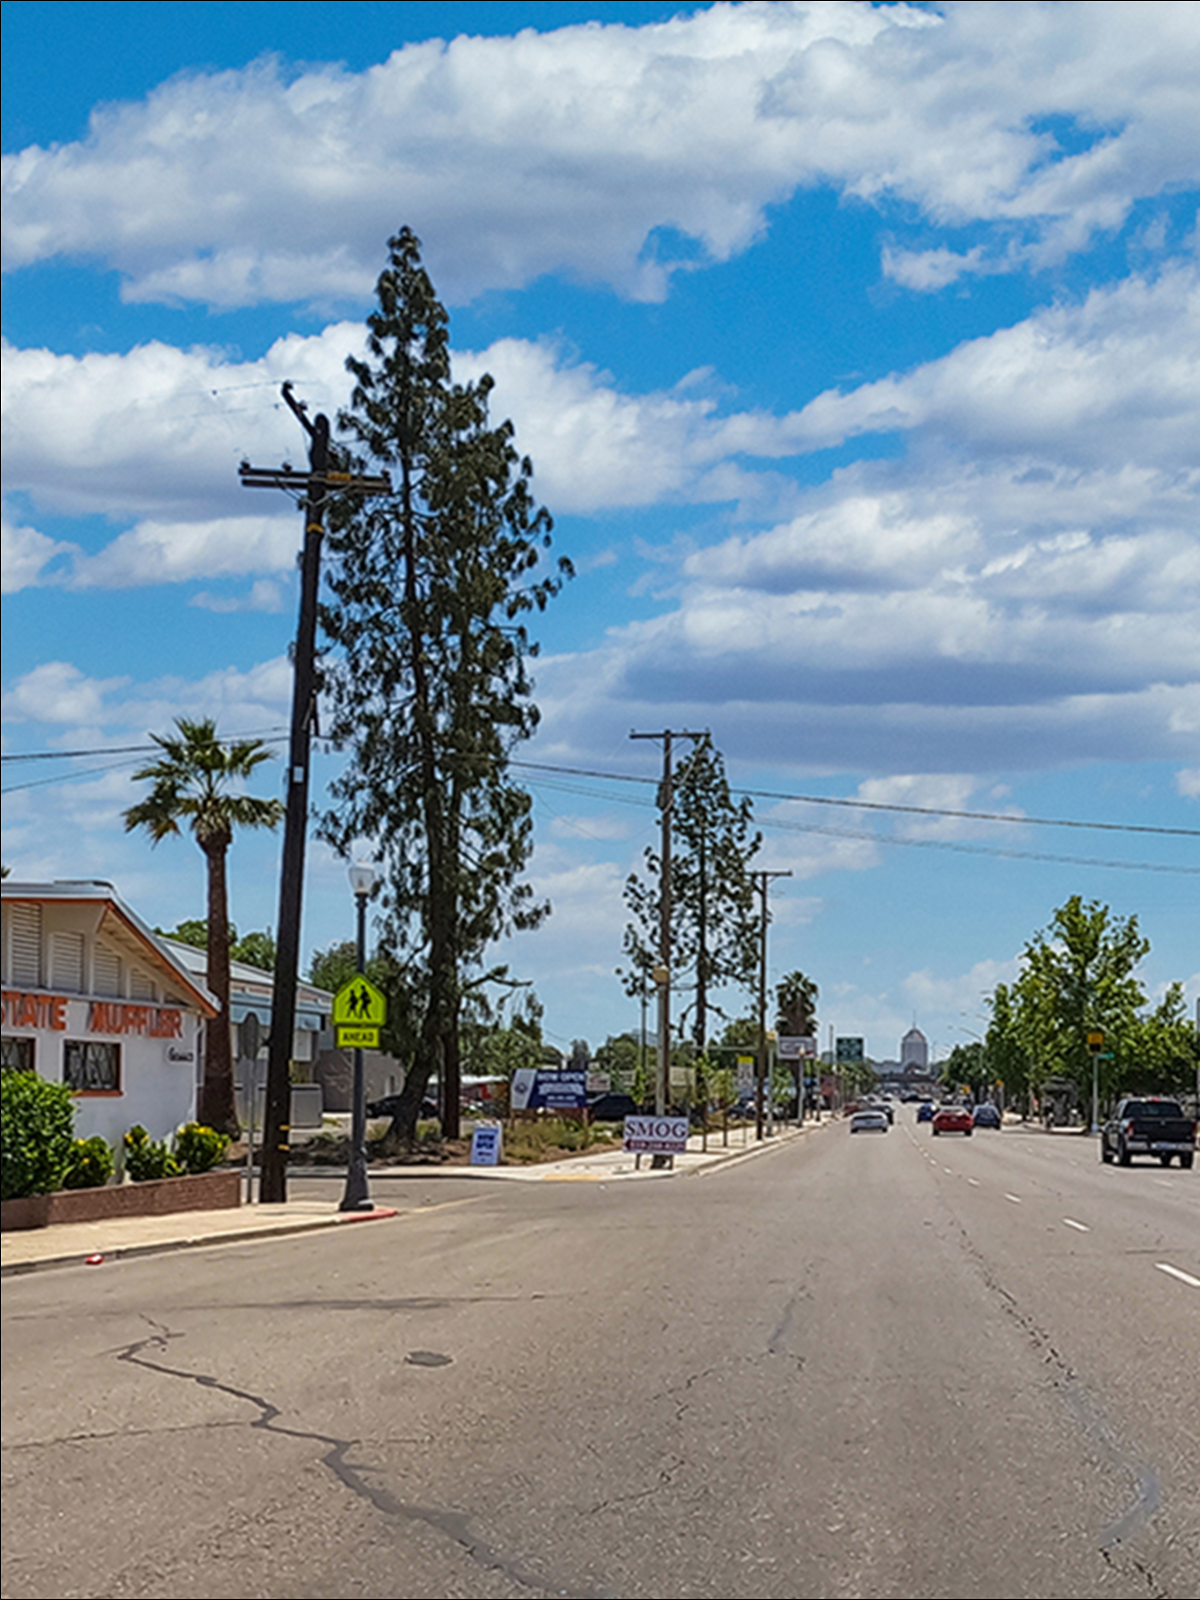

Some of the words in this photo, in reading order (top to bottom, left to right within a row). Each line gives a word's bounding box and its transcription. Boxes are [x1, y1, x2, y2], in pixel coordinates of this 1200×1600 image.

[87, 1000, 183, 1039] MUFFLER
[342, 1031, 375, 1042] AHEAD
[625, 1121, 687, 1139] SMOG
